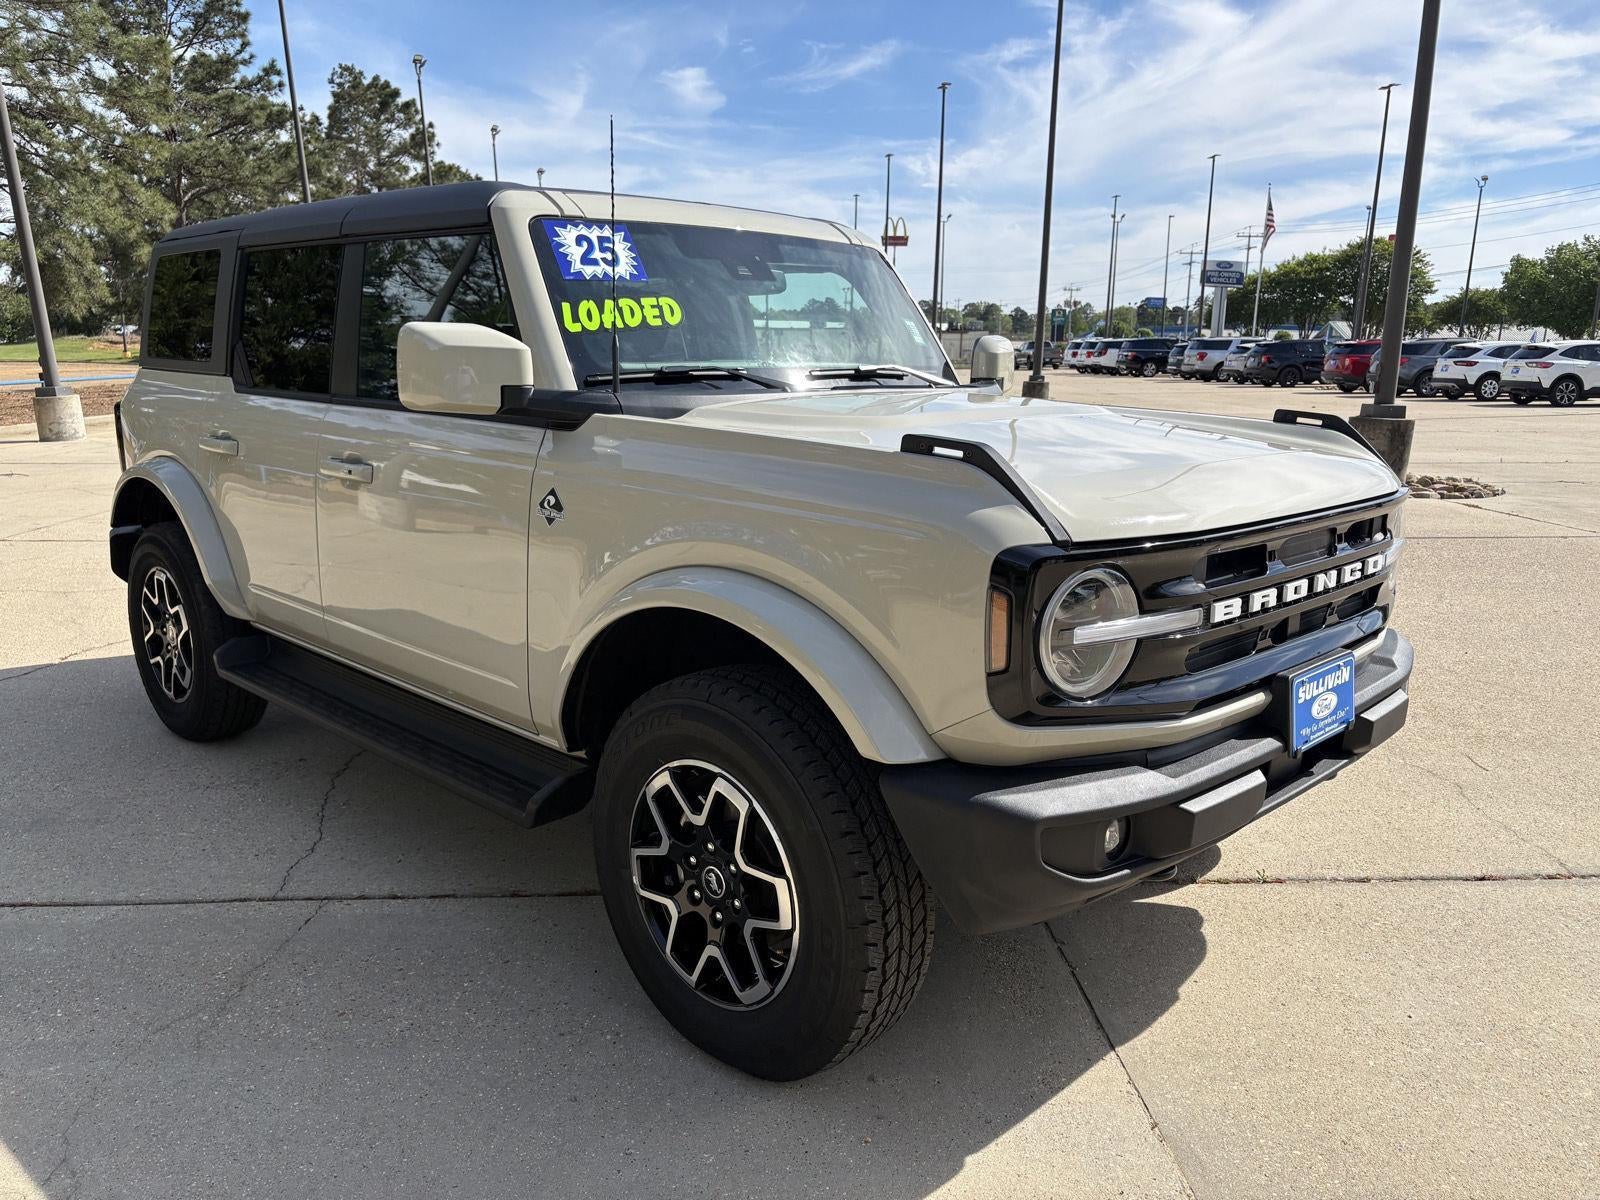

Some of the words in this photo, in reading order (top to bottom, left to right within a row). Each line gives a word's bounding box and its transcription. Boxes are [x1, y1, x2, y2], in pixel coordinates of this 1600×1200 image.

[575, 234, 621, 268] 25
[561, 297, 682, 333] LOADED
[1210, 554, 1385, 623] BRONCO
[1298, 666, 1350, 704] SULLIVAN
